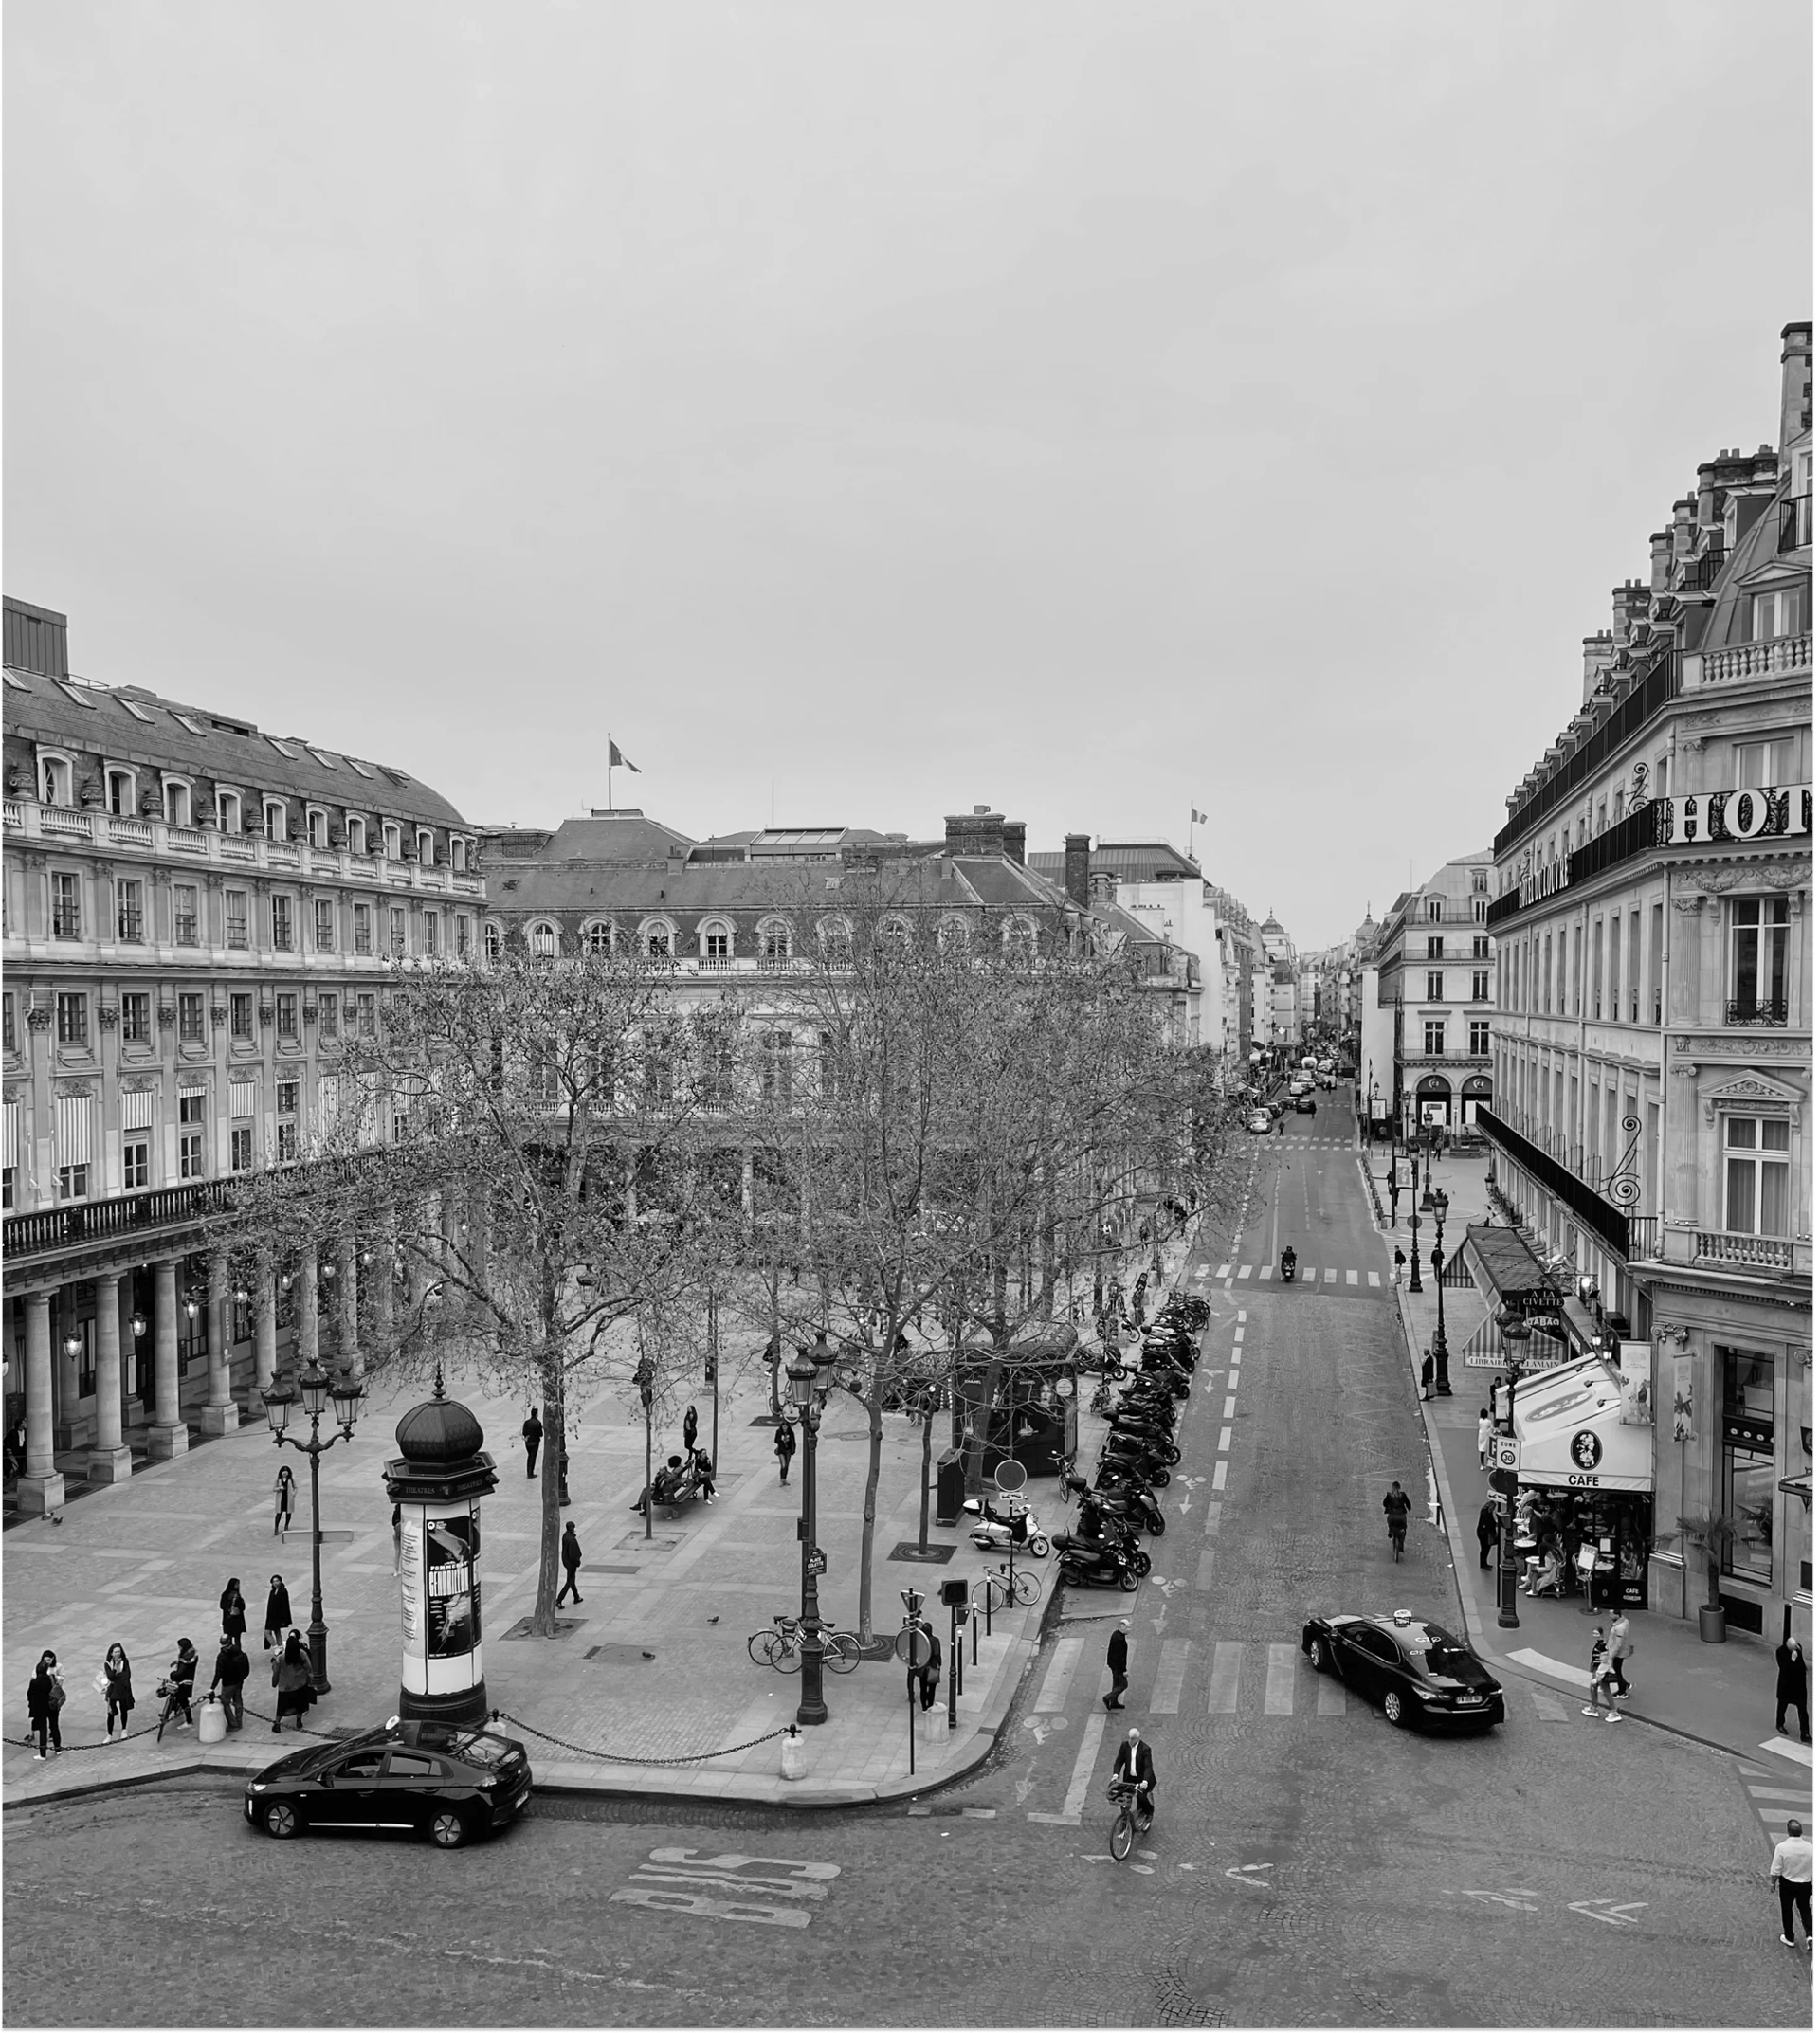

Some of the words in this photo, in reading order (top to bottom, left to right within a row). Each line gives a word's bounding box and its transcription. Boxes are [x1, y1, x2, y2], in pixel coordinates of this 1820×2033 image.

[1668, 783, 1814, 844] HOT
[1522, 1298, 1563, 1306] CIVETTE
[1568, 1475, 1599, 1486] CAFE
[608, 1847, 841, 1929] BUS
